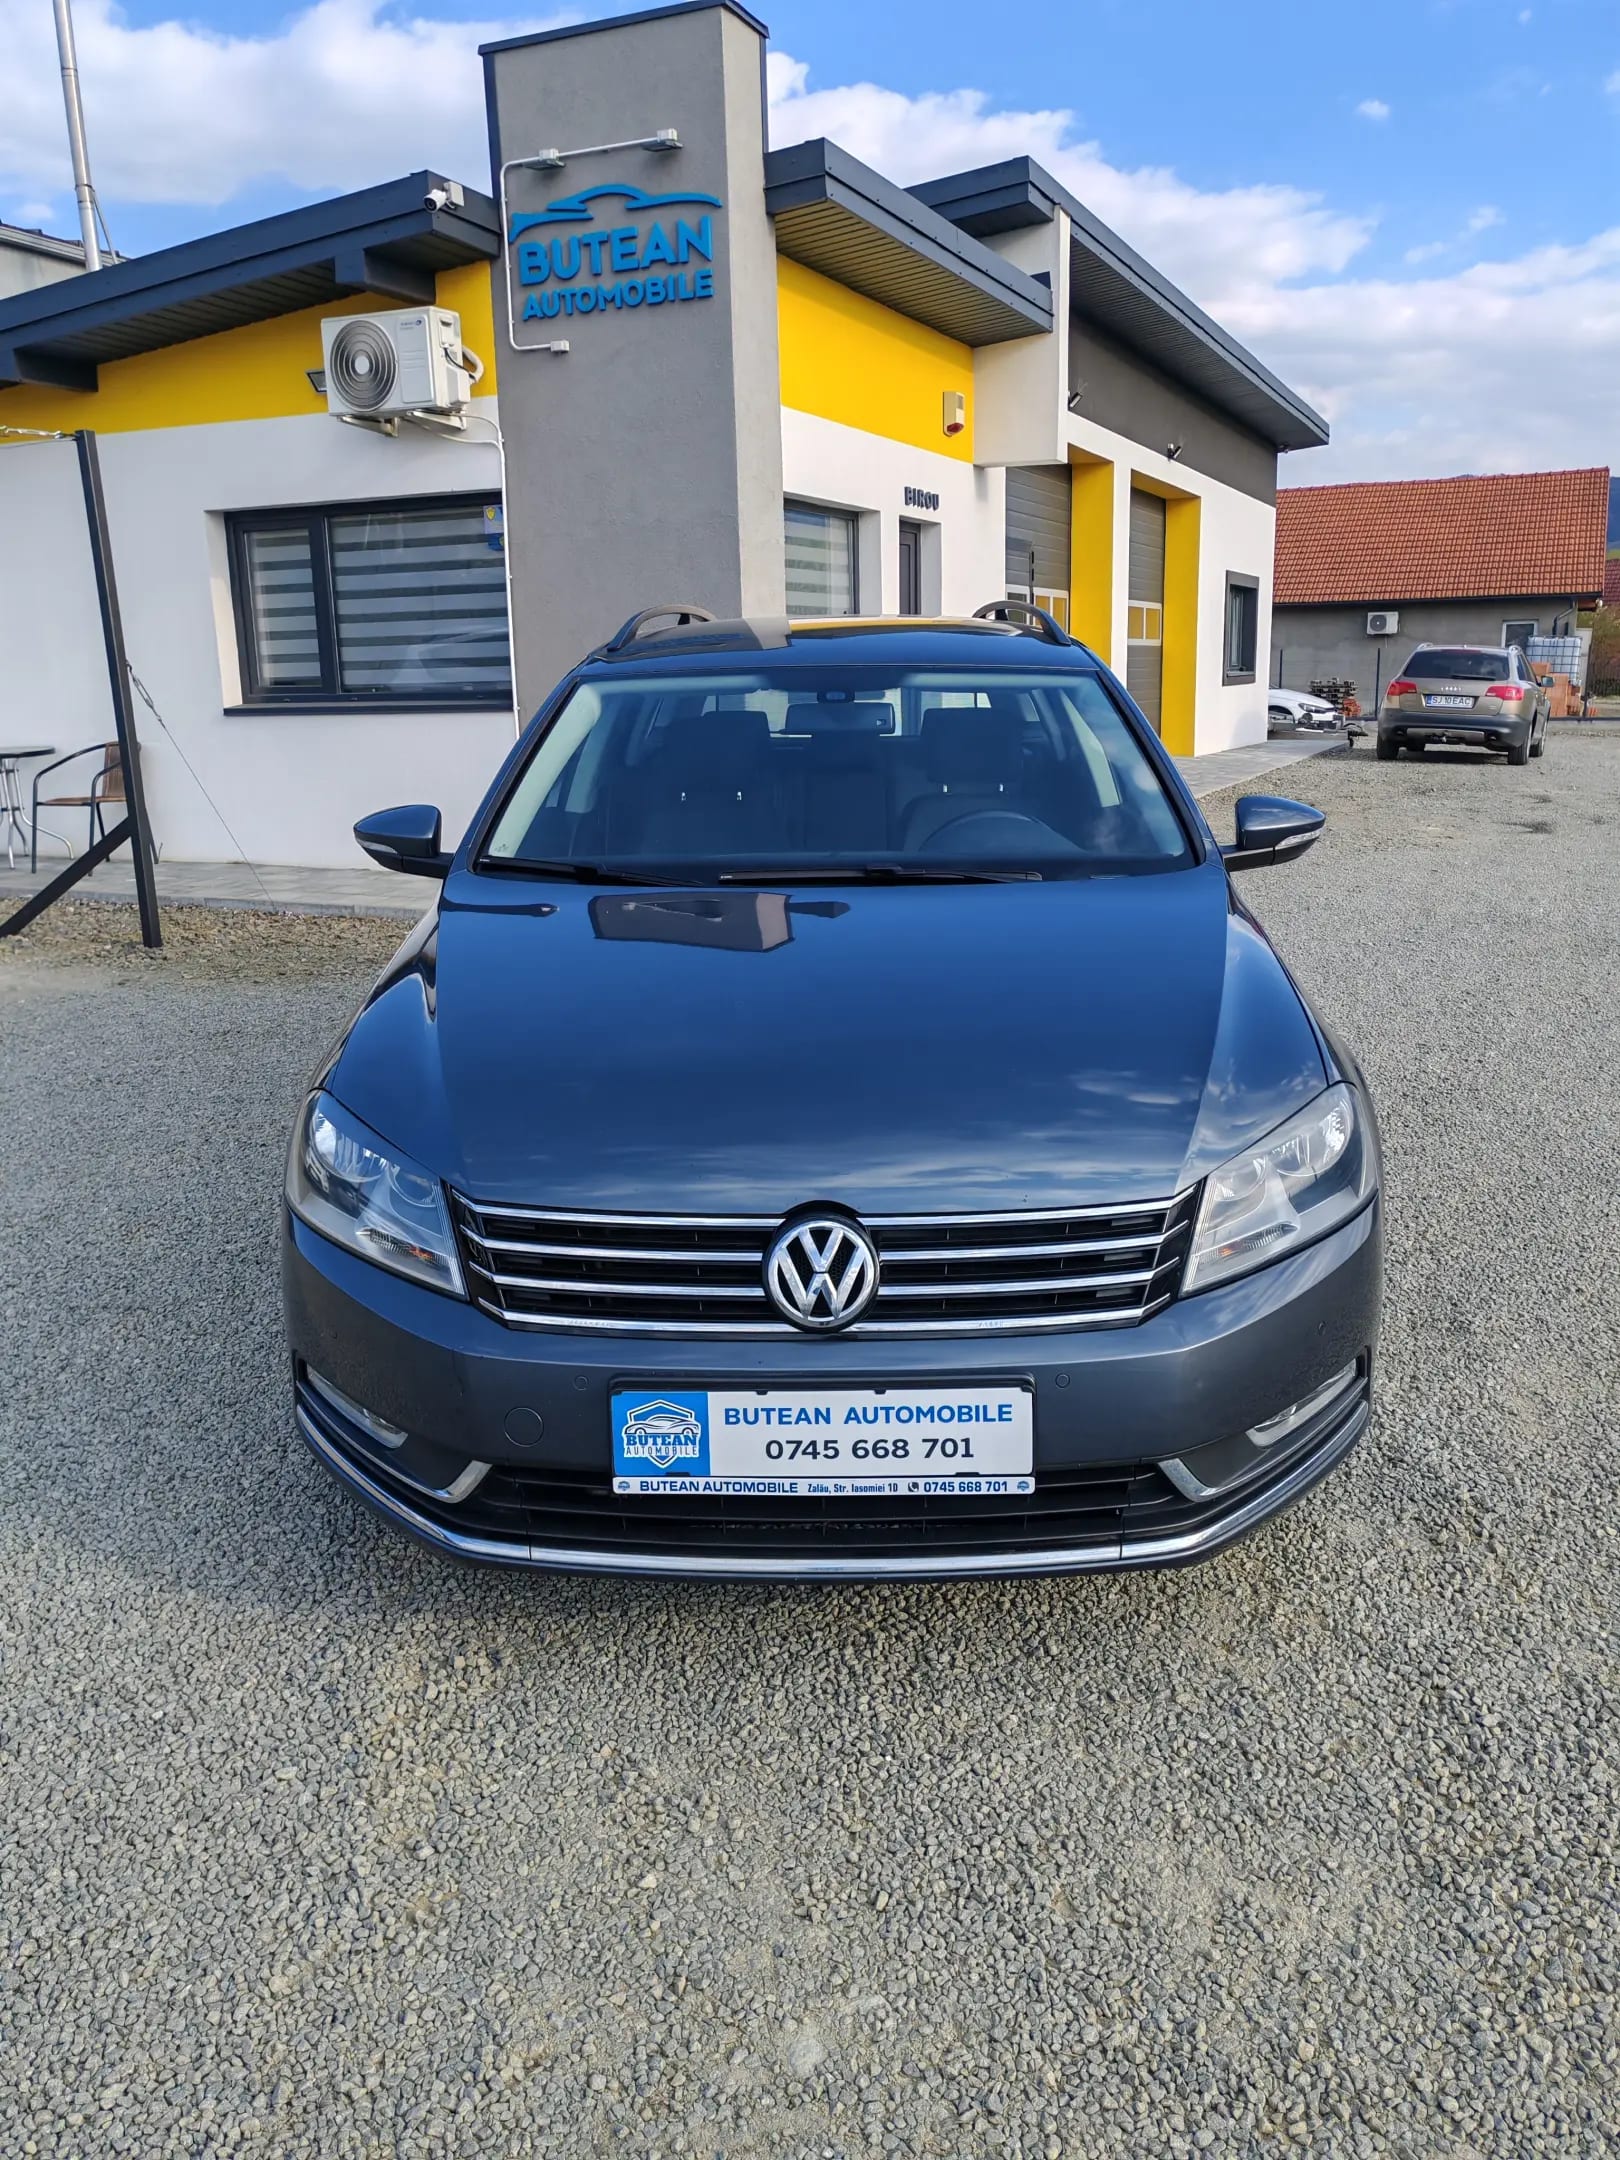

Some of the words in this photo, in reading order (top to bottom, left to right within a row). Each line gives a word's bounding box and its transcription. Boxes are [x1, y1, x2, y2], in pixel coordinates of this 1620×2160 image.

[518, 215, 713, 287] BUTEAN
[522, 268, 714, 321] AUTOMOBILE
[904, 486, 939, 511] BIROU
[724, 1406, 831, 1425] BUTEAN
[844, 1404, 1013, 1424] AUTOMOBILE
[625, 1434, 697, 1446] BUTEAN
[625, 1446, 697, 1456] AUTOMOBILE
[765, 1440, 840, 1460] 0745
[852, 1438, 910, 1459] 668
[922, 1437, 974, 1458] 701
[639, 1480, 700, 1492] BUTEAN
[702, 1481, 798, 1494] AUTOMOBILE
[833, 1483, 849, 1493] Str.
[851, 1483, 885, 1493] Iasomiei
[923, 1481, 955, 1493] 0745
[958, 1481, 982, 1492] 668
[985, 1480, 1008, 1492] 701
